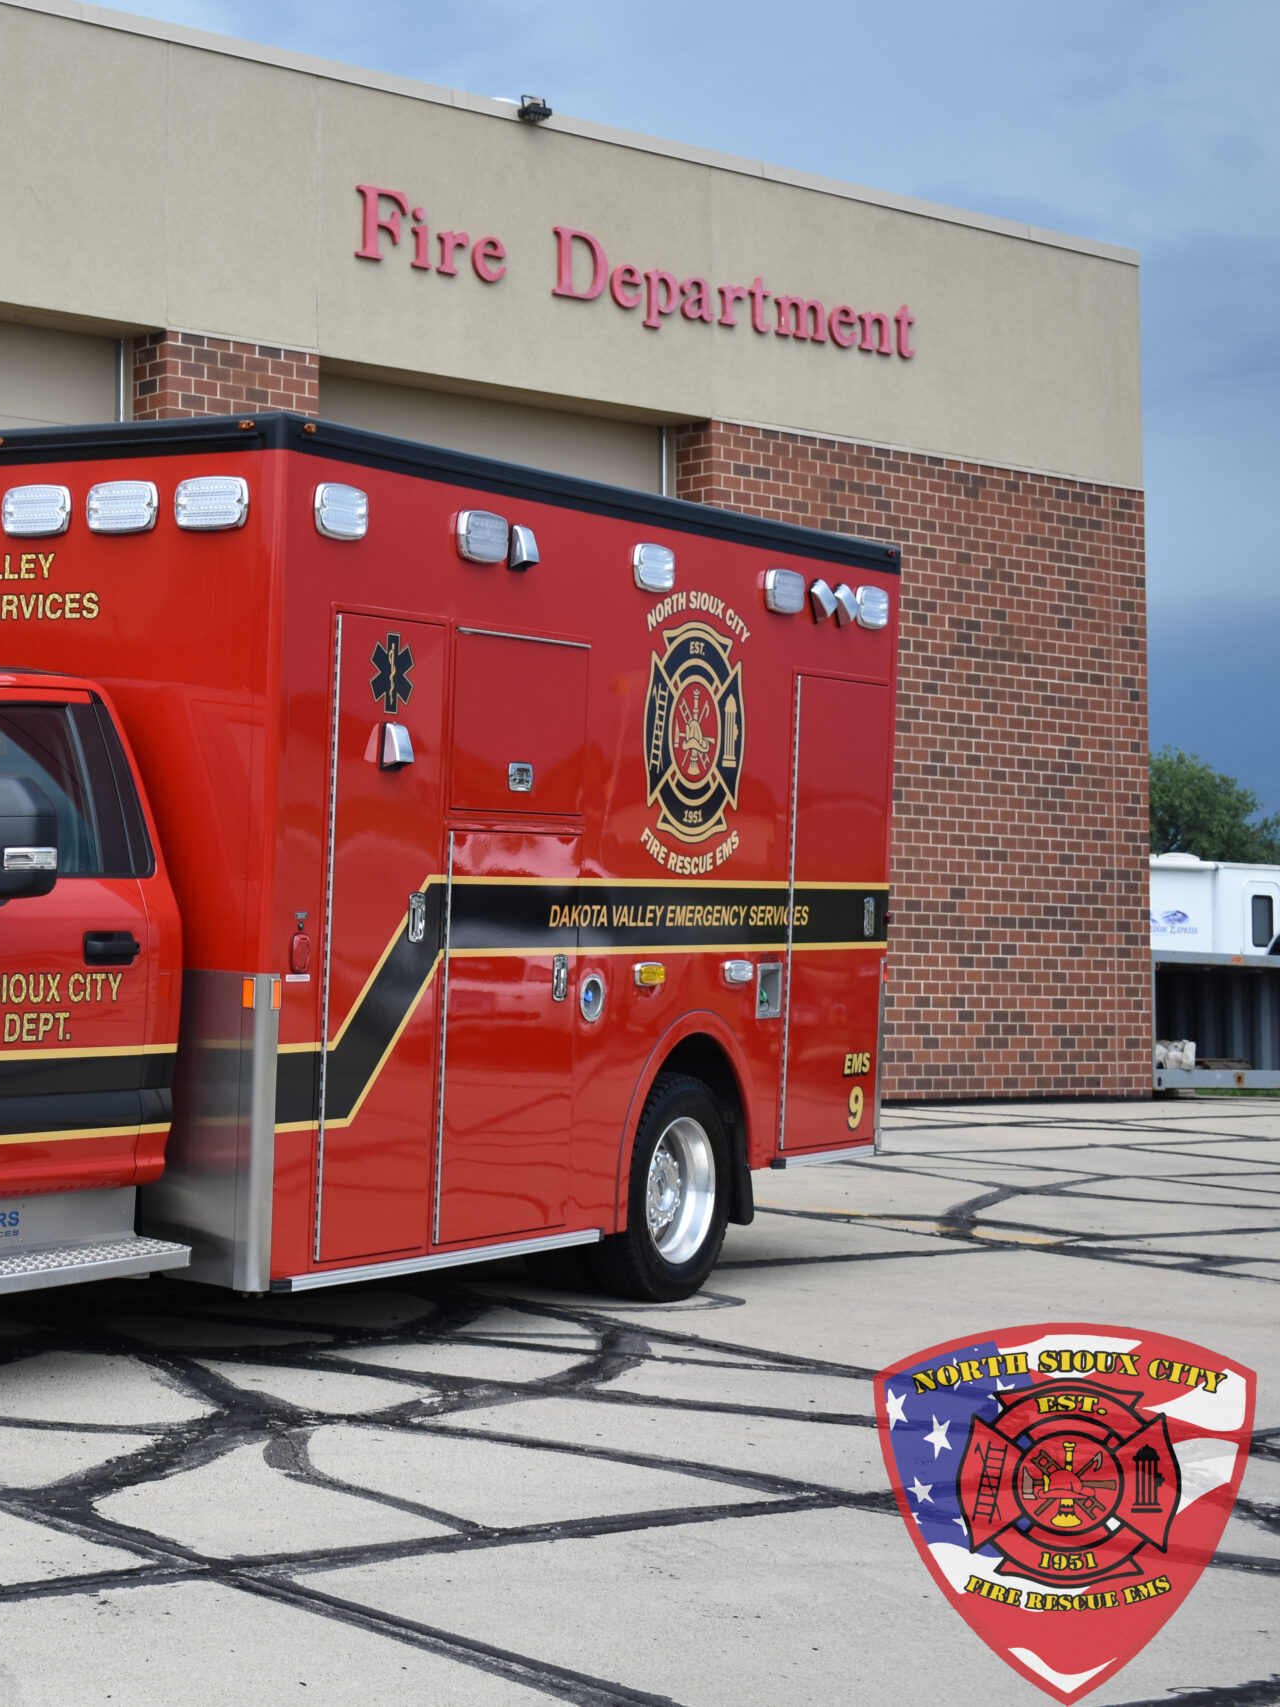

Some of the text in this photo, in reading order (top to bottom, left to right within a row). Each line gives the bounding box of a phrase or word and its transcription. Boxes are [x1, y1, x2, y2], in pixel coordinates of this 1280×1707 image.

[354, 184, 916, 359] Fire Department
[646, 590, 751, 643] NORTH SIOUX CITY
[689, 641, 706, 656] EST.
[682, 809, 703, 824] 1951
[640, 826, 740, 876] FIRE RESCUE EMS
[548, 905, 809, 928] DAKOTA VALLEY EMERGENCY SERVICES
[68, 972, 123, 1003] CITY
[3, 1011, 72, 1044] DEPT.
[842, 1052, 871, 1078] EMS
[846, 1085, 864, 1130] 9
